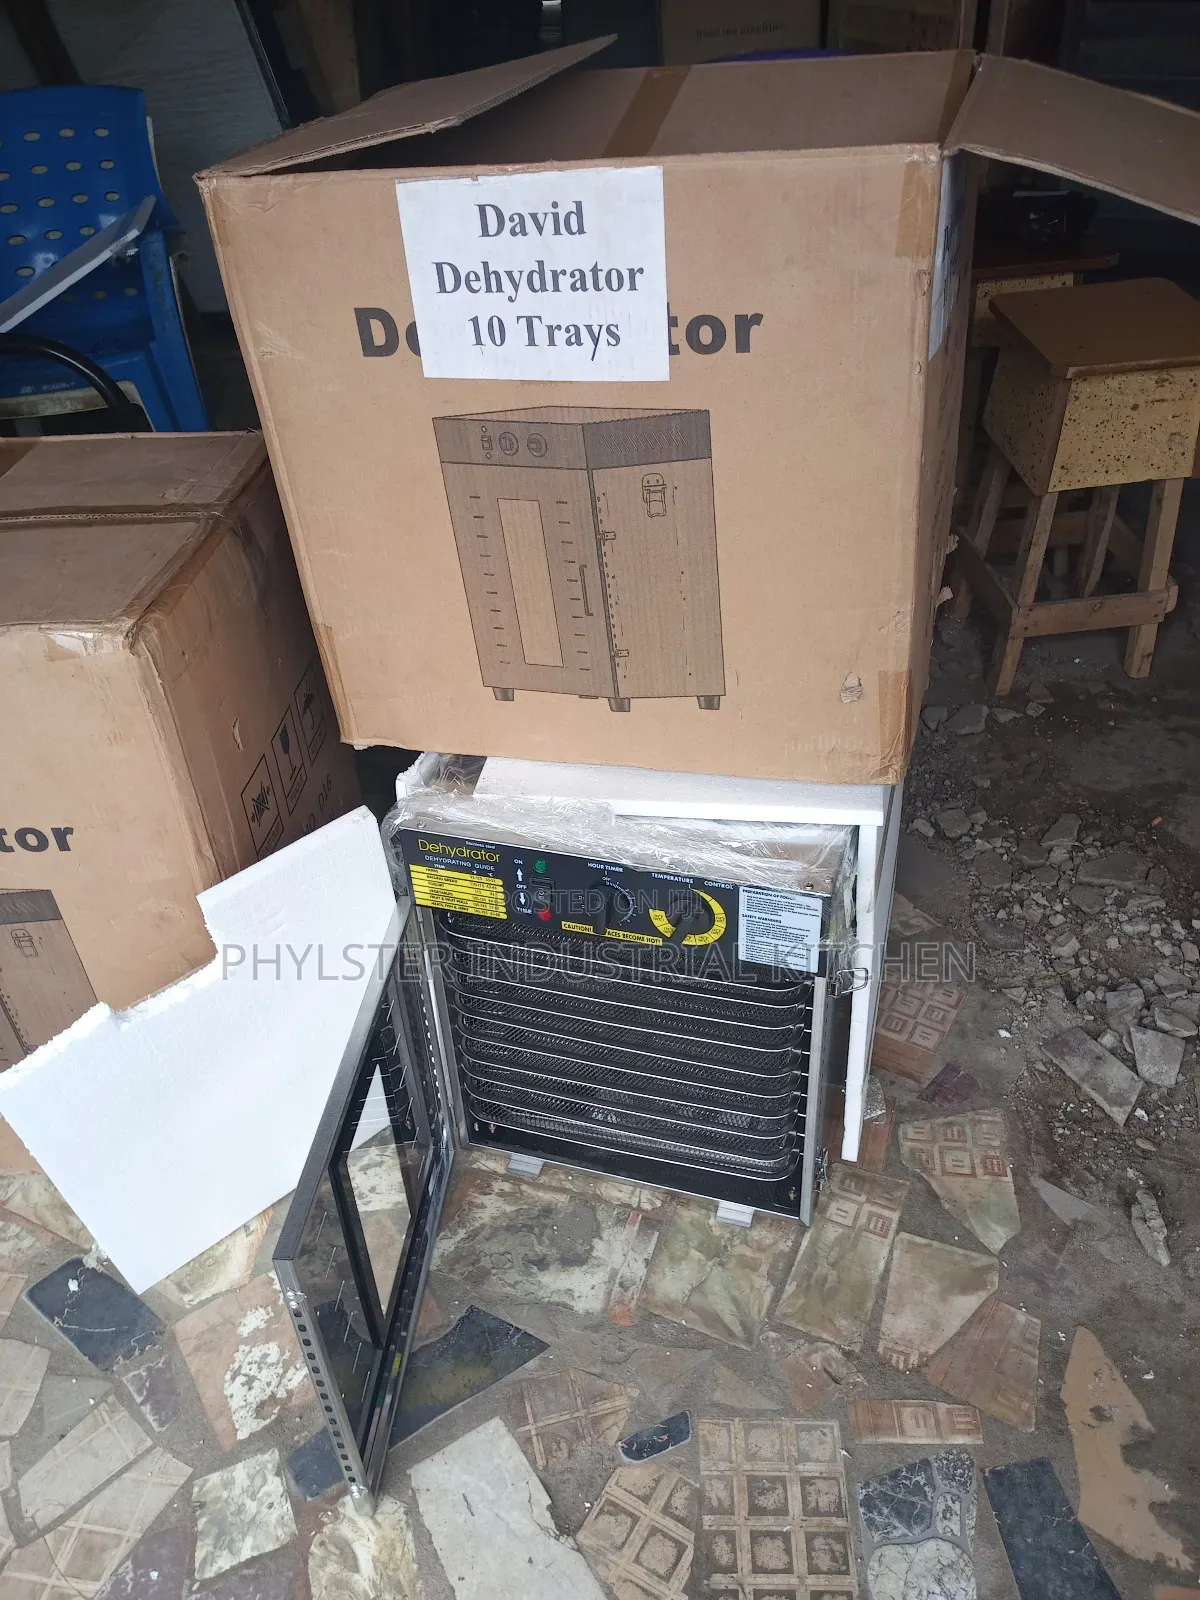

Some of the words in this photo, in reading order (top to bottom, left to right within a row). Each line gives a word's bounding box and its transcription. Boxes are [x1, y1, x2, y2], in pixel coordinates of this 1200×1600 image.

[475, 200, 587, 238] David
[432, 260, 645, 302] Dehydrator
[468, 315, 507, 347] 10
[517, 315, 621, 361] Trays
[418, 839, 500, 862] Dehydrator
[424, 855, 472, 868] DEHYDRATING
[474, 863, 496, 872] GUIDE
[587, 862, 605, 870] HOUR
[604, 864, 624, 873] TIMER
[652, 872, 694, 884] TEMPERATURE
[704, 880, 734, 890] CONTROL
[563, 923, 592, 933] CAUTION!
[607, 930, 621, 938] ACES
[622, 932, 645, 941] BECOME
